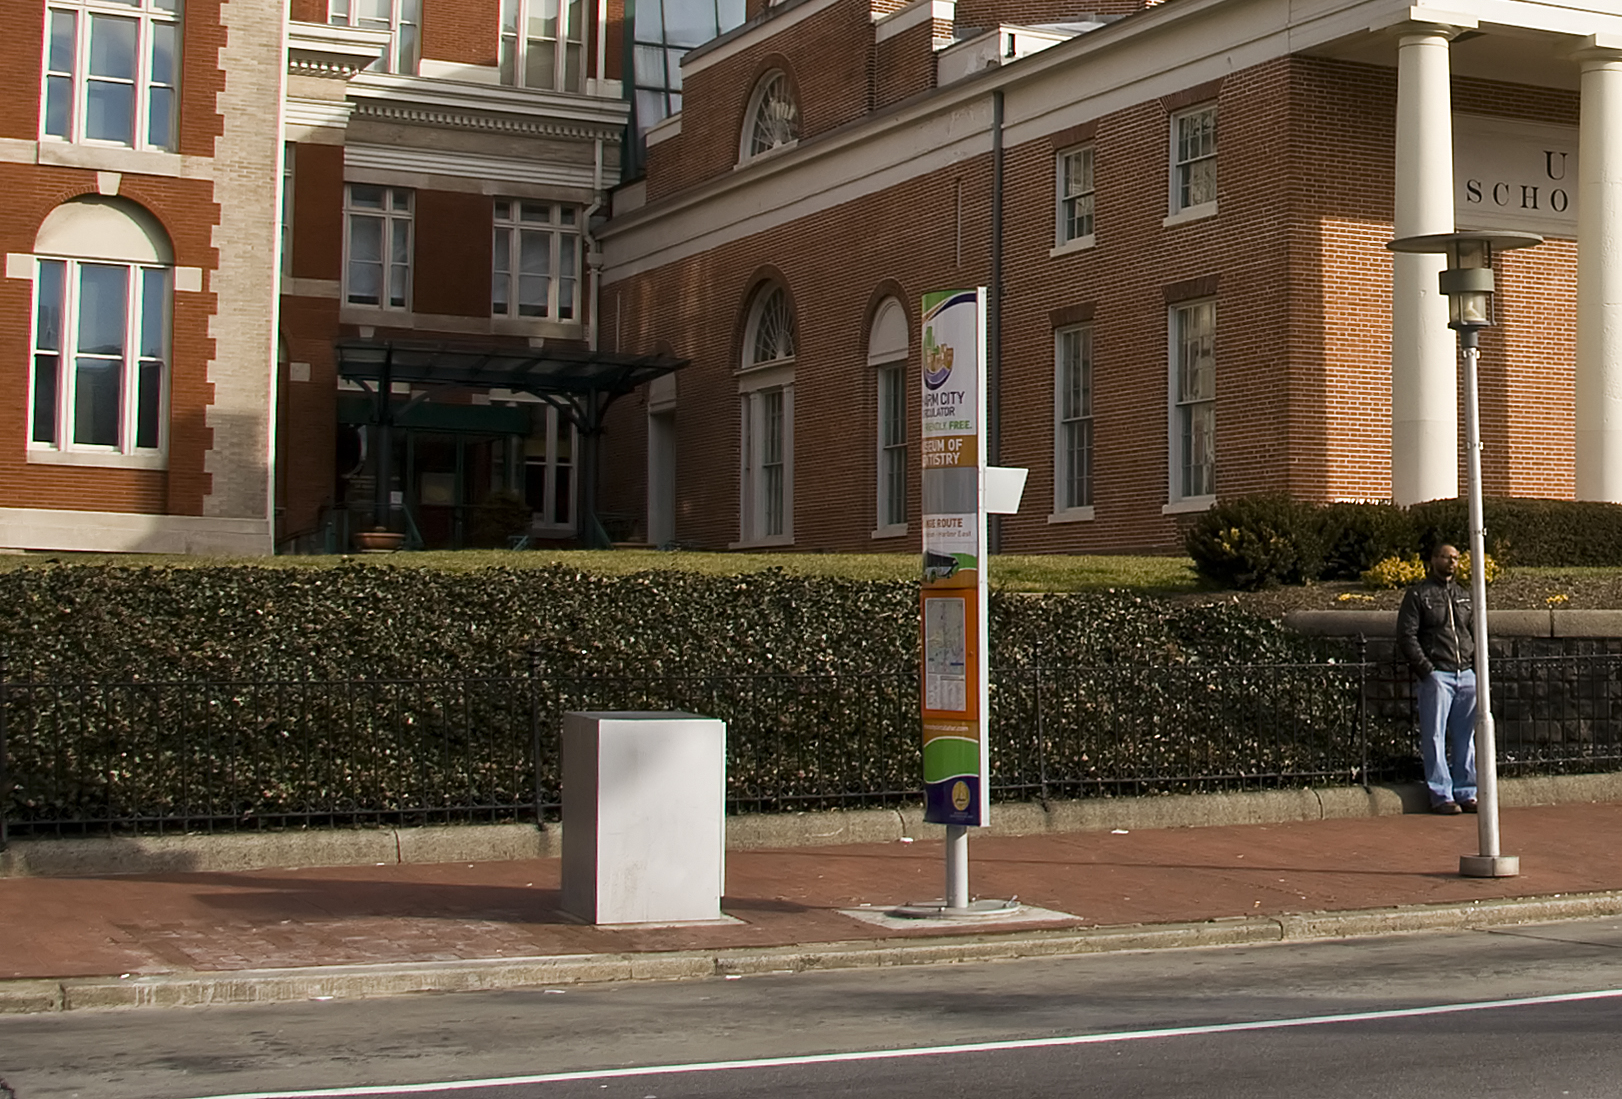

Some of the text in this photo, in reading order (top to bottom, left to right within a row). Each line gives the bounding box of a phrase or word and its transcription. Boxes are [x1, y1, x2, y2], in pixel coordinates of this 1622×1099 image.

[1466, 179, 1569, 213] SCHO
[940, 391, 965, 405] CITY
[948, 438, 963, 452] OF
